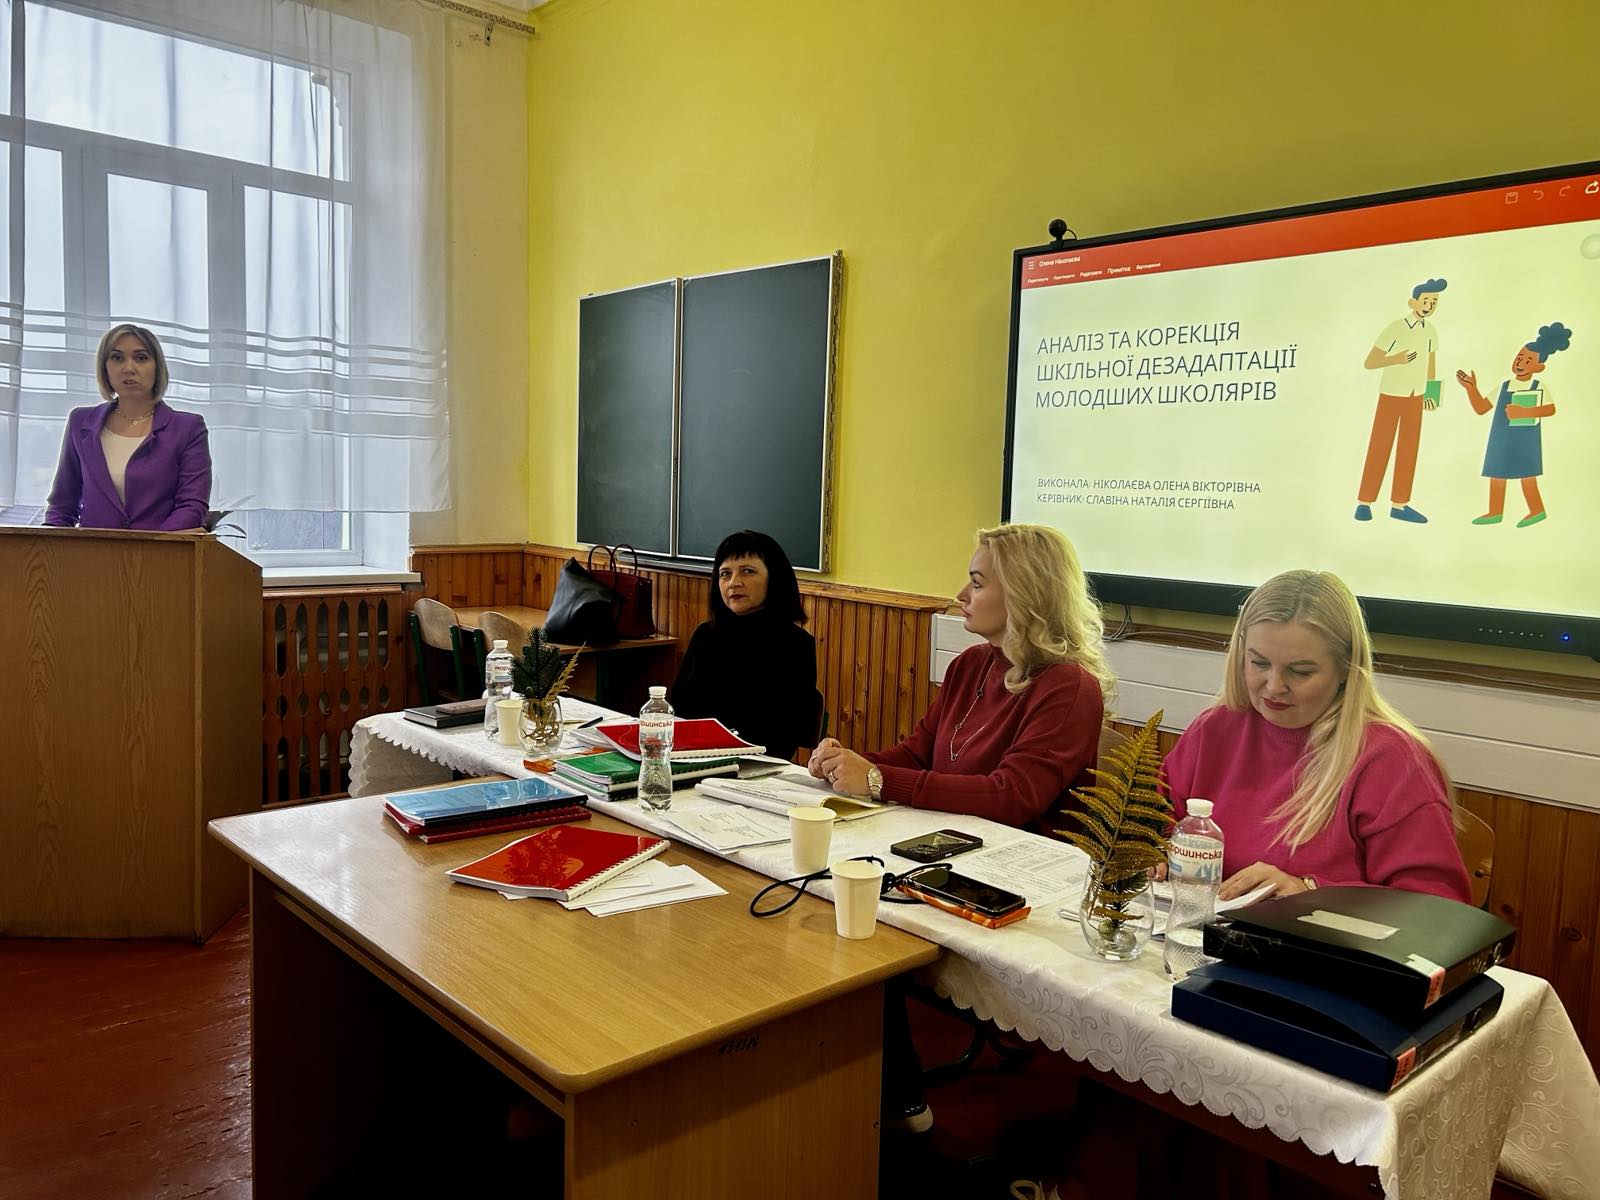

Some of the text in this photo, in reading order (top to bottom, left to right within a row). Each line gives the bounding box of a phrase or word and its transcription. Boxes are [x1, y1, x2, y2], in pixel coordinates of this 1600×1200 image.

[1037, 321, 1241, 355] АНАЛІЗ ТА КОРЕКЦІЯ
[1036, 344, 1298, 382] ШКІЛЬНОЇ ДЕЗАДАПТАЦІЇ
[1035, 381, 1277, 410] МОЛОДШИХ ШКОЛЯРІВ
[1093, 479, 1151, 491] НІКОЛАЄВА
[1153, 480, 1190, 492] ОЛЕНА
[1192, 481, 1261, 493] ВІКТОРІВНА
[1036, 493, 1235, 510] КЕРІВНИК: СЛАВІНА НАТАЛІЯ СЕРГІЇВНА
